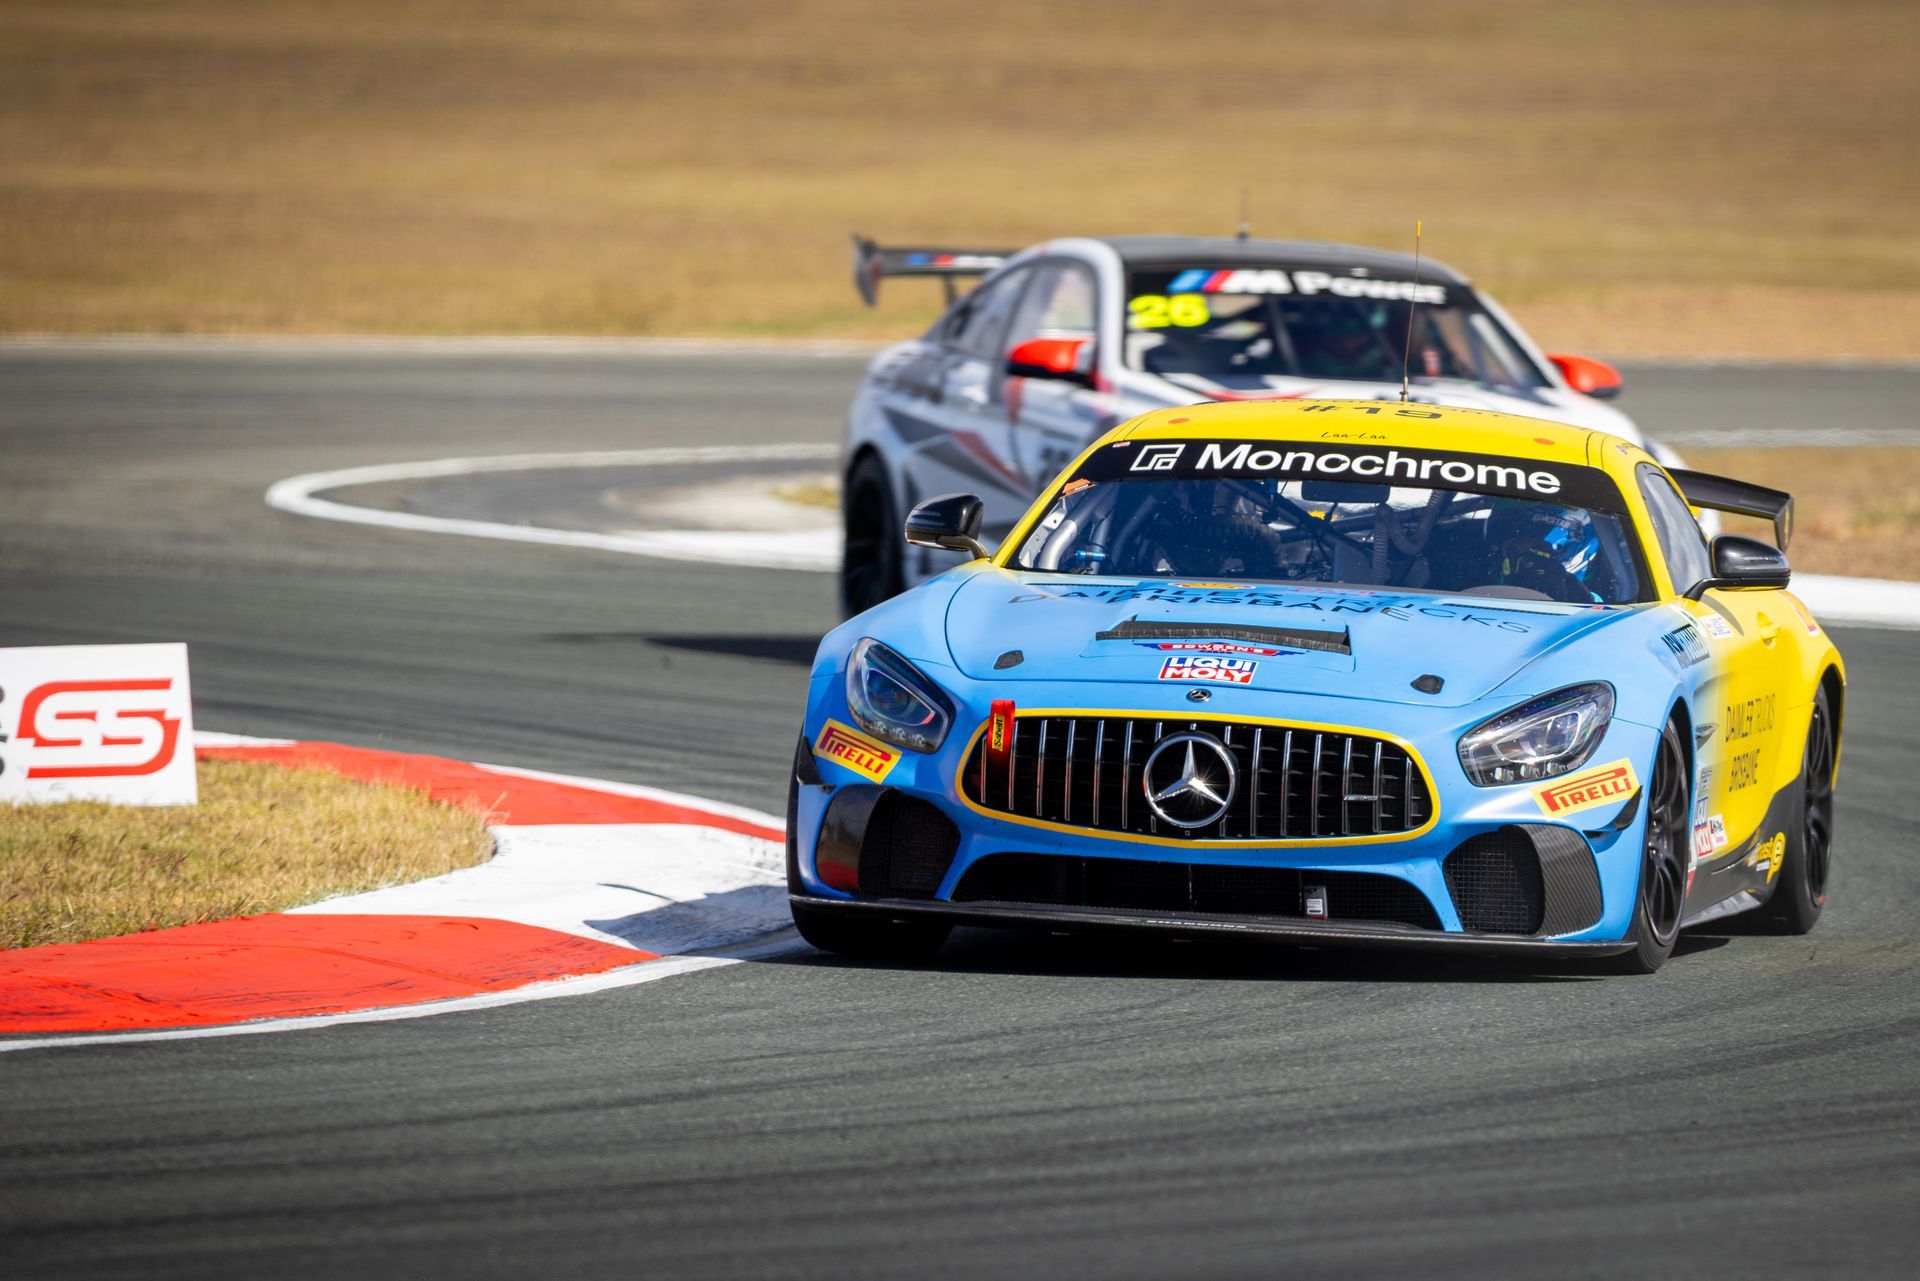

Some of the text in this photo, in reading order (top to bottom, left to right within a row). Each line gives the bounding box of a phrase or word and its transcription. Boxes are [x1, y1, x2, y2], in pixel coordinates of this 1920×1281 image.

[1292, 270, 1448, 305] Power
[1127, 293, 1211, 329] 26
[1194, 442, 1562, 495] Monochrome
[1008, 587, 1284, 605] DAIMLER
[1305, 595, 1532, 634] TRUCKS
[1105, 593, 1415, 622] BRISBANE
[1164, 667, 1254, 683] MOLY
[1167, 656, 1256, 672] LIQUI
[992, 715, 1005, 749] Sabelt
[818, 725, 893, 775] PIRELLI
[1539, 766, 1633, 813] PIRELLI
